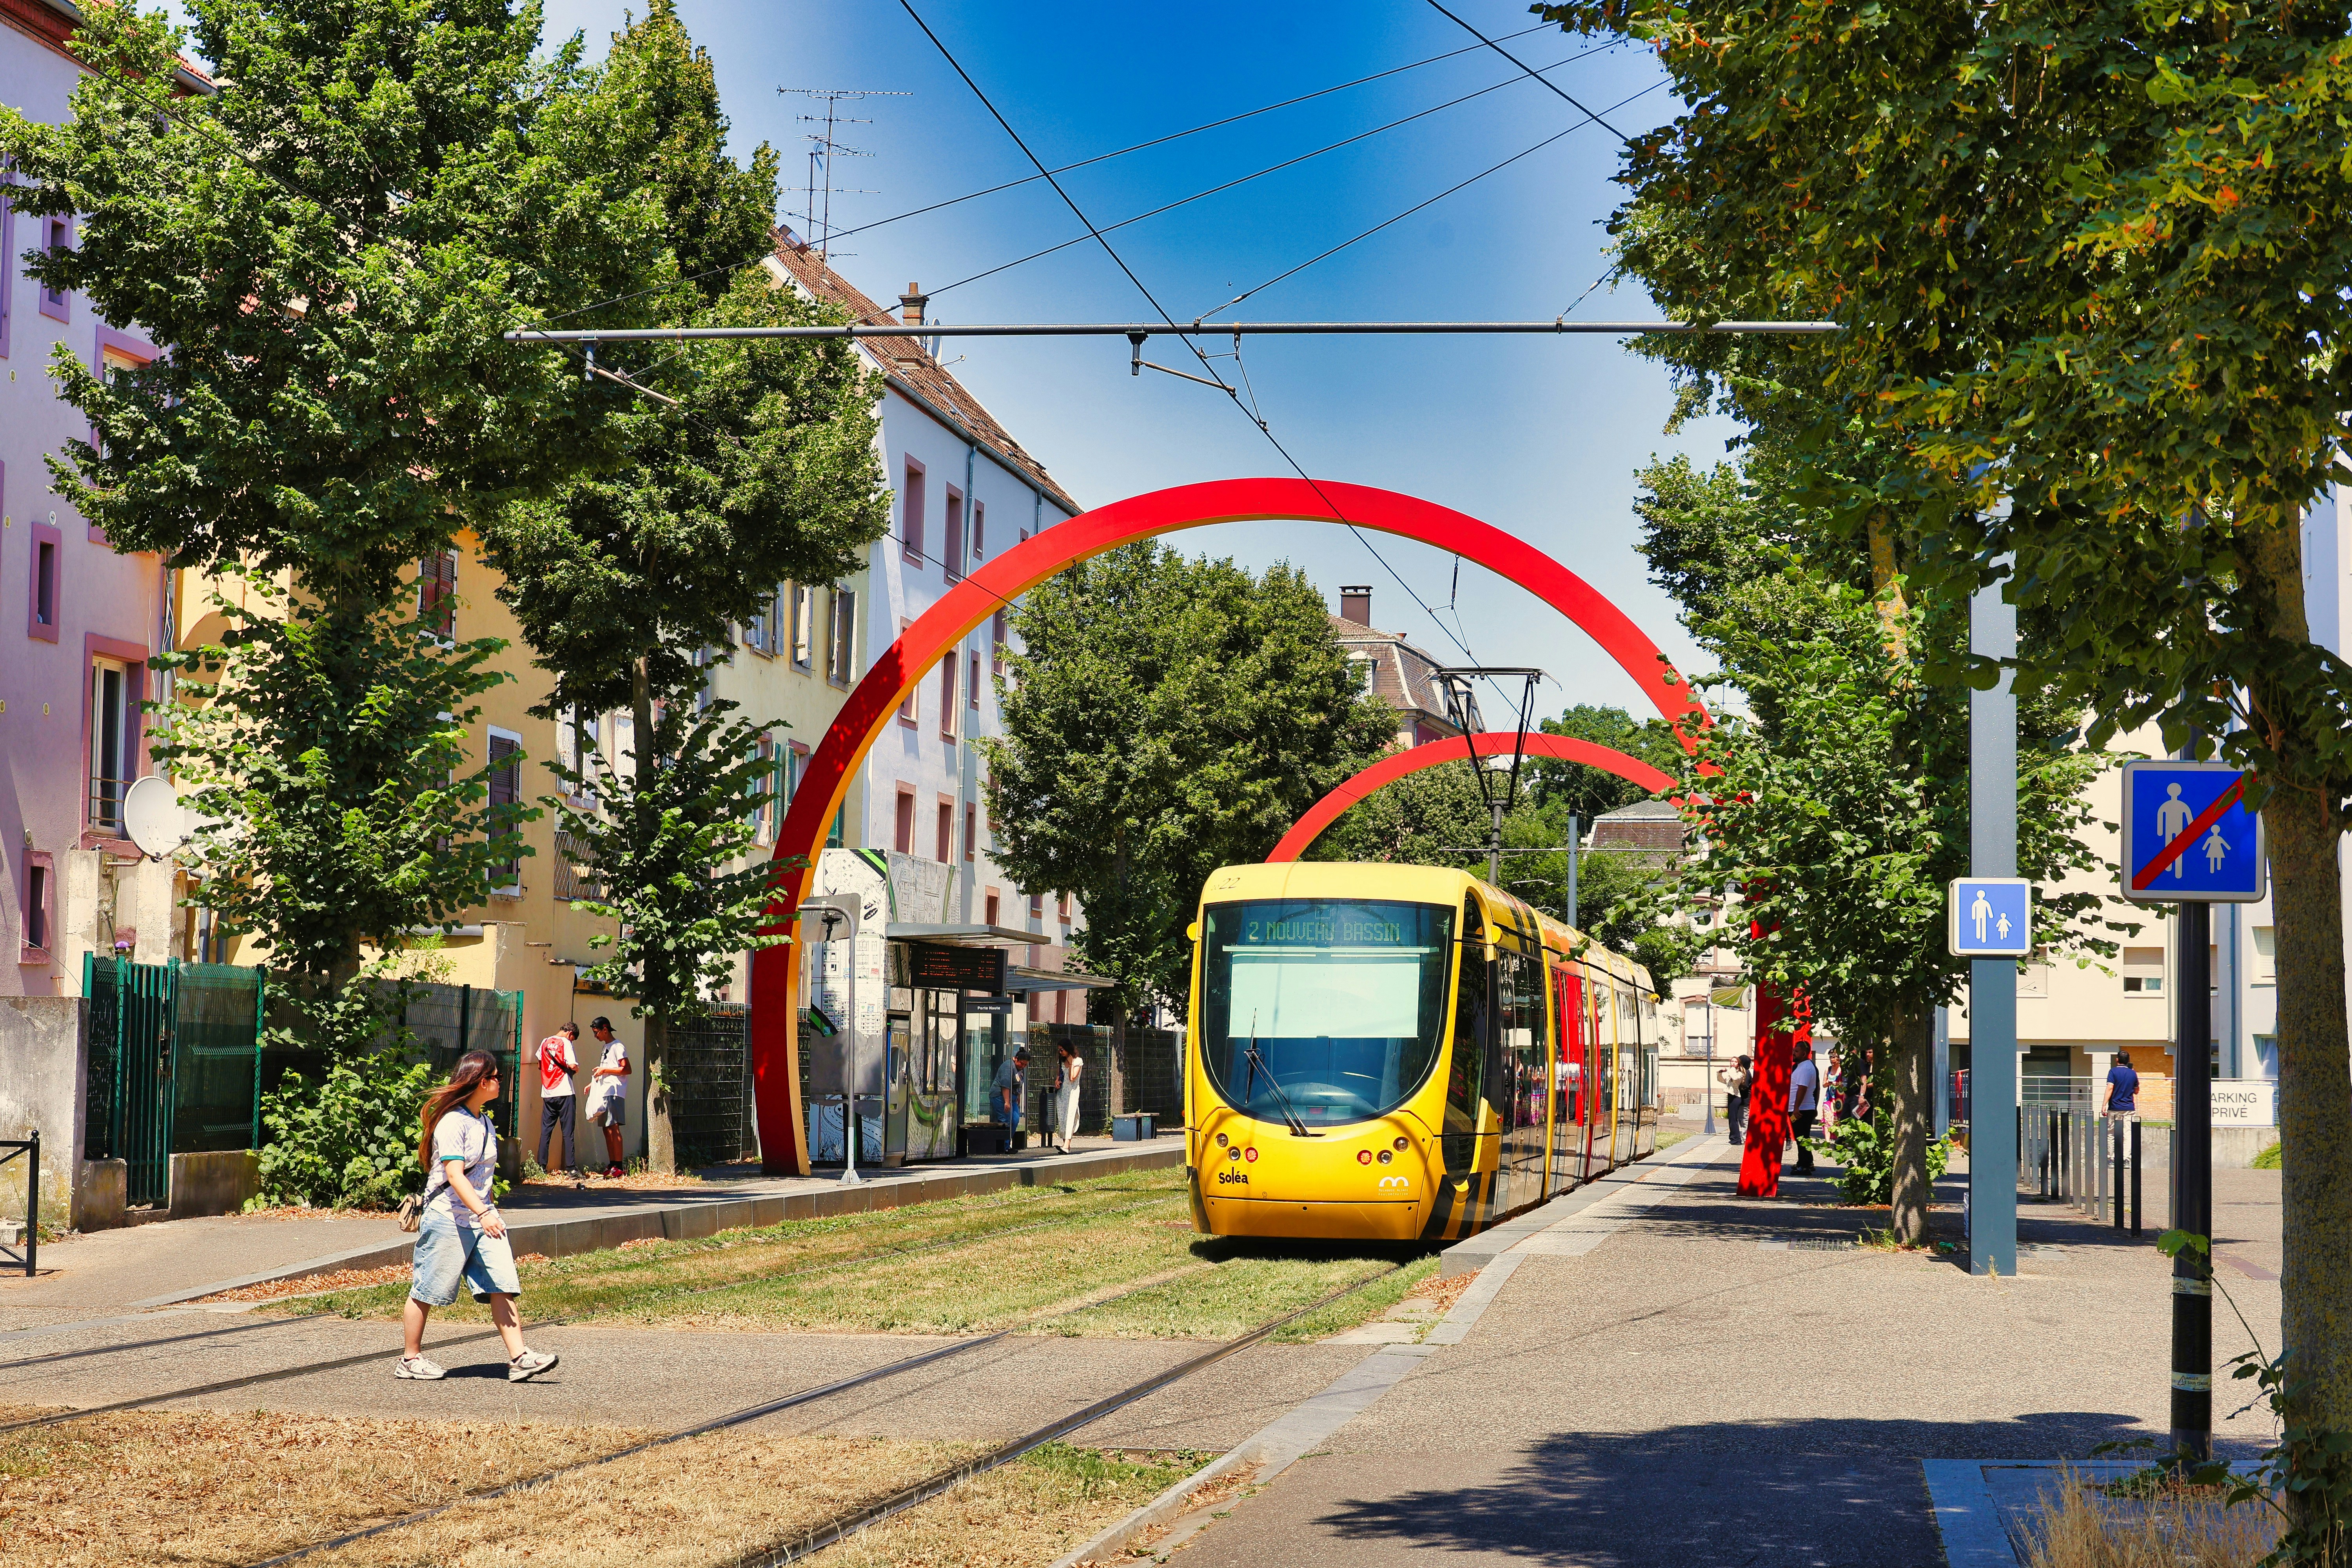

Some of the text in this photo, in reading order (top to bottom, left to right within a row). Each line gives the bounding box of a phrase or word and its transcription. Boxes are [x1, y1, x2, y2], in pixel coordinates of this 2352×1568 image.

[1249, 922, 1399, 941] 2 NOUVEAU BASSIN
[2211, 1093, 2257, 1103] ARKING
[2212, 1105, 2248, 1118] PRIVÉ
